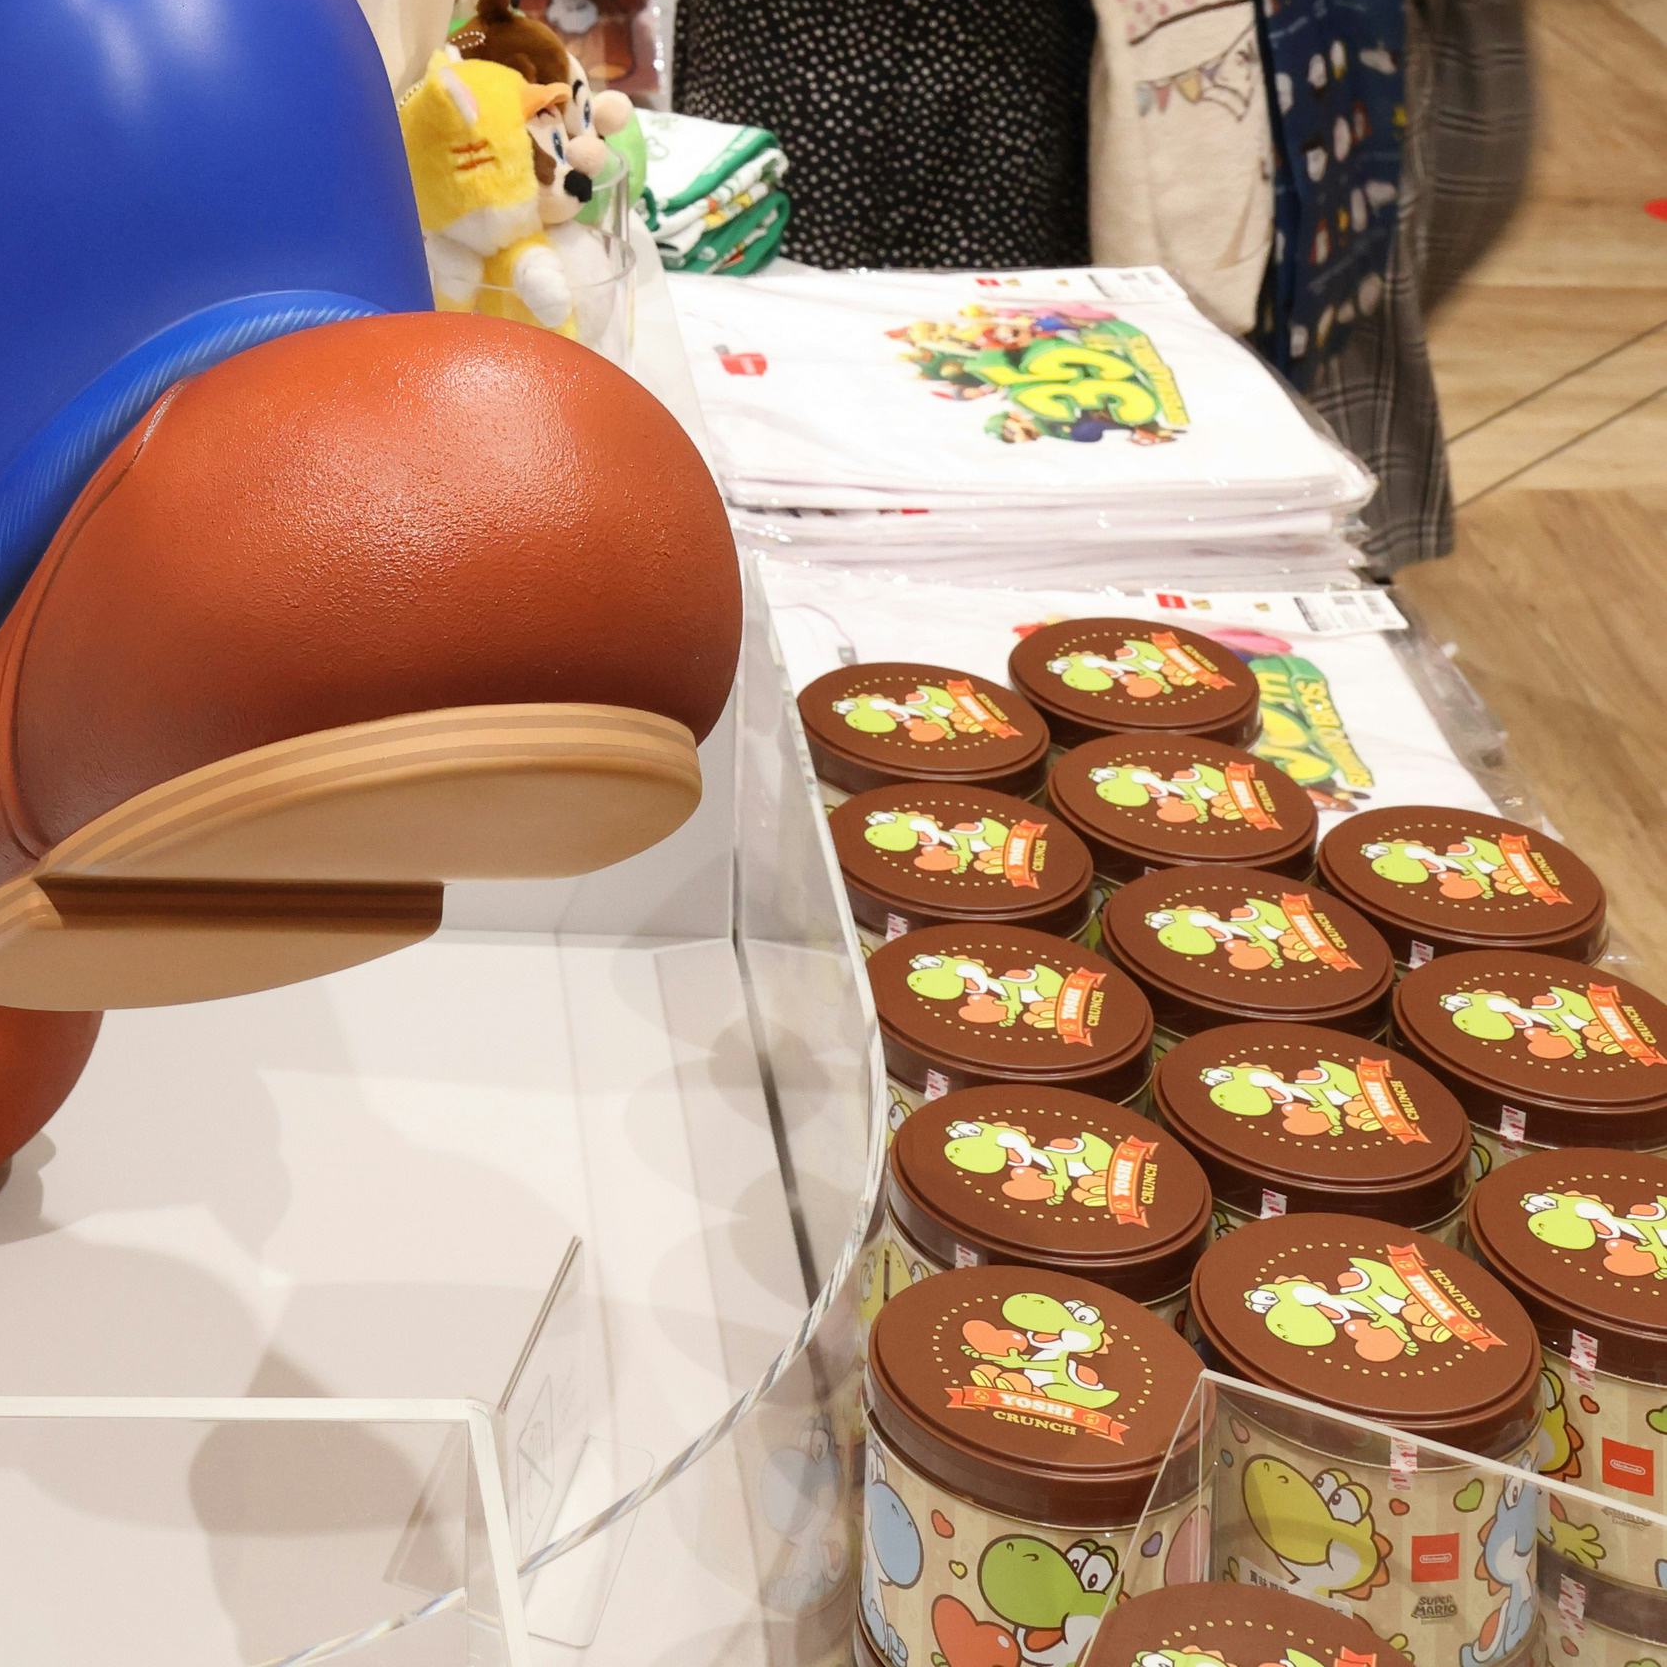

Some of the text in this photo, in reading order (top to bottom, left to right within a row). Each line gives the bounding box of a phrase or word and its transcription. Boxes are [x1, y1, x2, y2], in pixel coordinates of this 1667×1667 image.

[1312, 912, 1348, 950] CRUNCH
[1086, 991, 1105, 1027] CRUNCH
[1621, 1004, 1657, 1045] CRUNCH
[1389, 1080, 1420, 1121] CRUNCH
[1112, 1160, 1134, 1197] YOSHI
[1139, 1163, 1158, 1205] CRUNCH
[1404, 1274, 1459, 1321] YOSHI
[1429, 1267, 1482, 1319] CRUNCH
[992, 1410, 1077, 1436] CRUNCH
[997, 1392, 1076, 1419] YOSHI
[1414, 1604, 1458, 1616] MARIO
